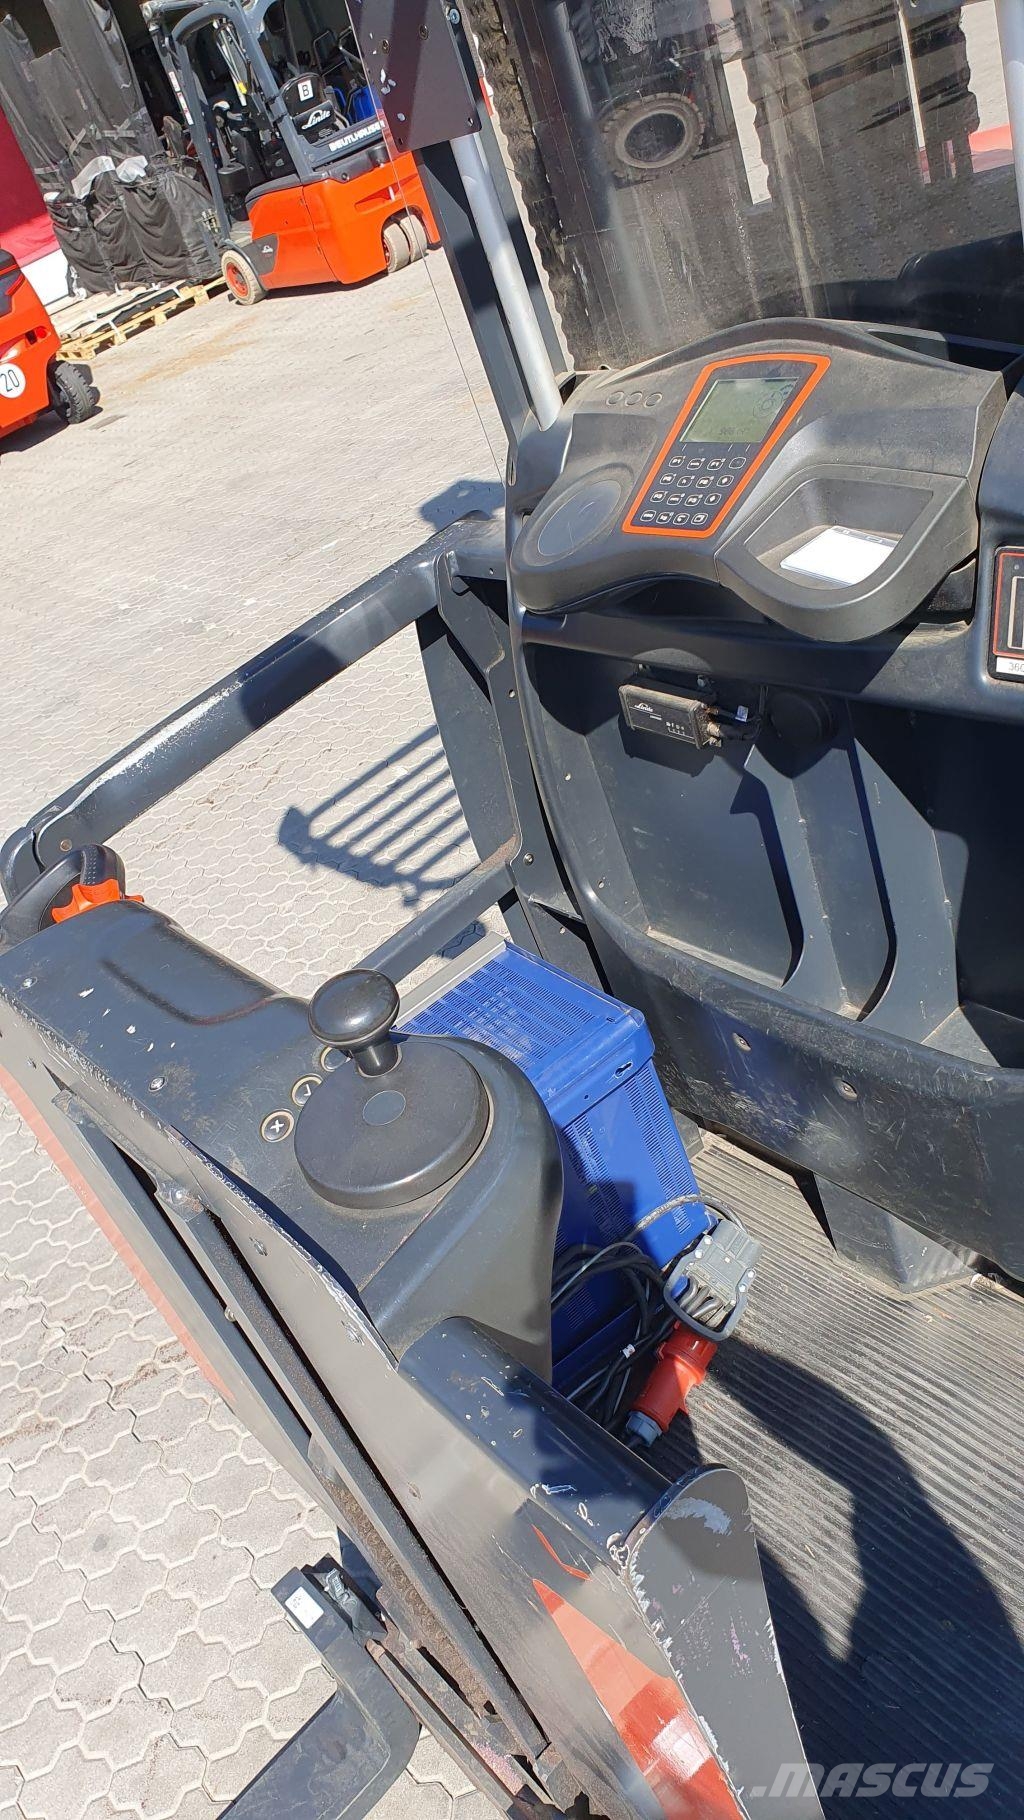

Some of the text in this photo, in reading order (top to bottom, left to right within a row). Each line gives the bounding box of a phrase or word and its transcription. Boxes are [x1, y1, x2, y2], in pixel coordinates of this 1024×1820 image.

[301, 84, 310, 97] B
[301, 109, 331, 130] Linde
[0, 369, 20, 392] 20
